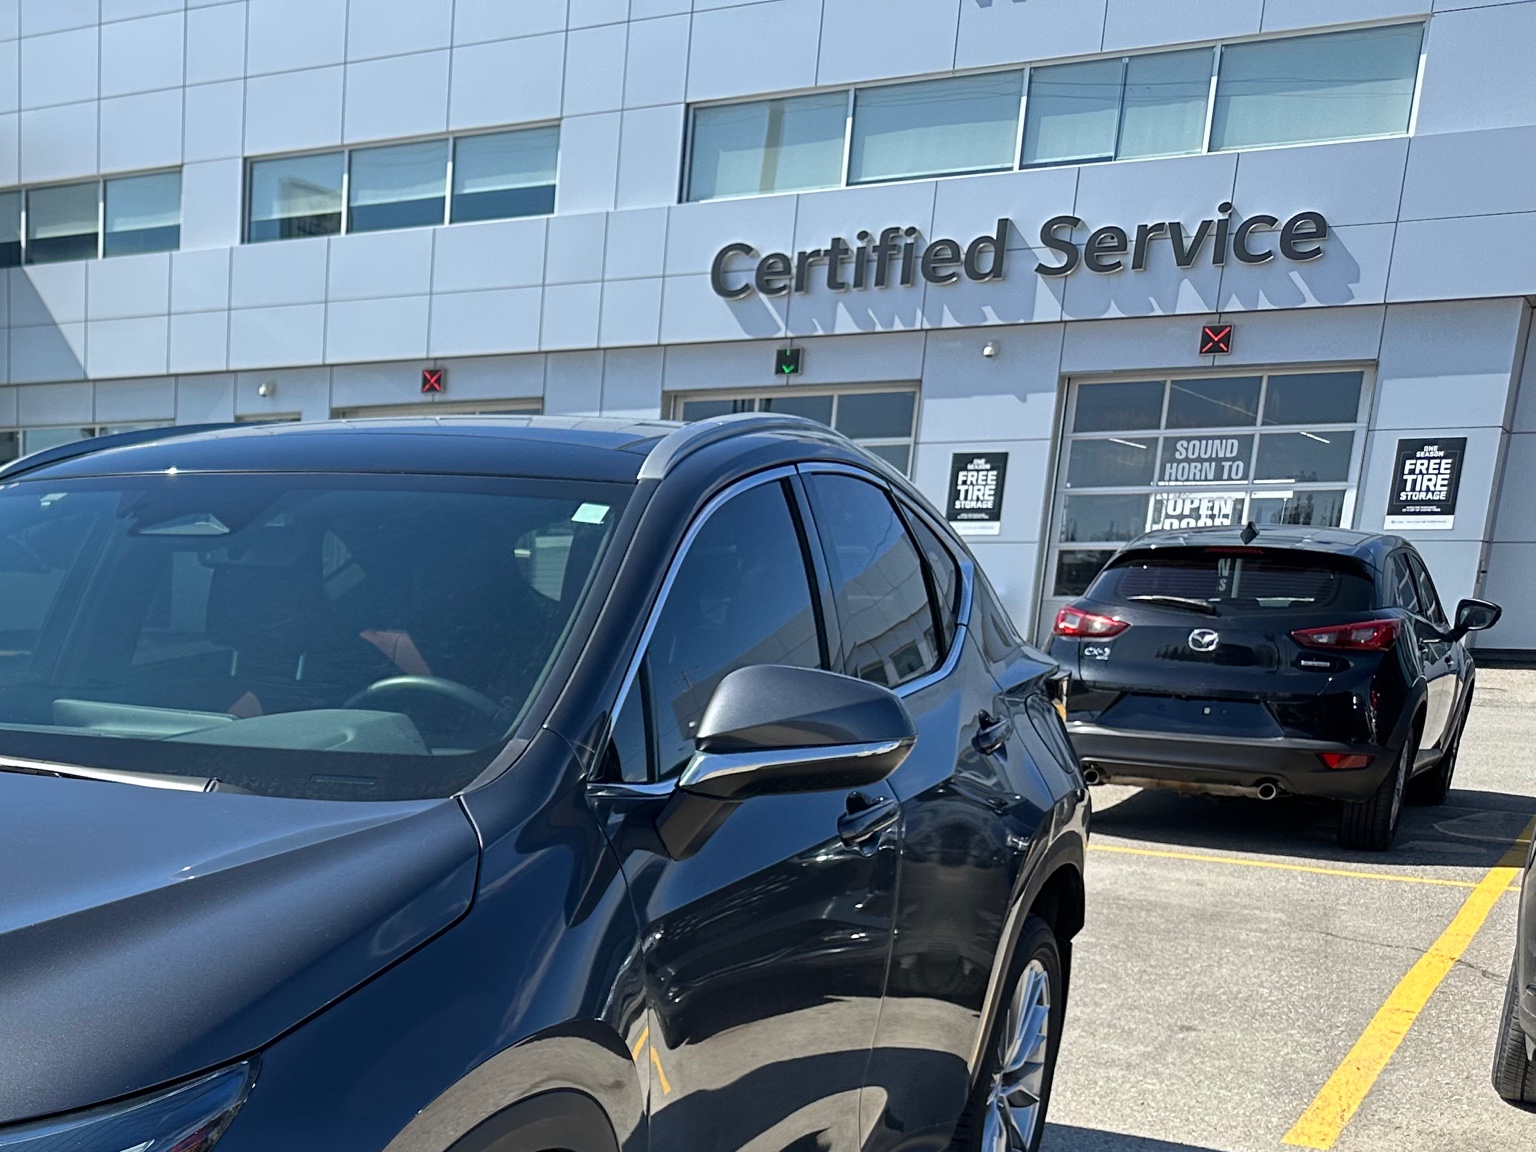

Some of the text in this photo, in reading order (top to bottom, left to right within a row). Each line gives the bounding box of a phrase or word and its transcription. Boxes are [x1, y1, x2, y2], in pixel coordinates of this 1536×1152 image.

[710, 201, 1330, 299] Certified Service
[1175, 439, 1239, 460] SOUND
[1164, 461, 1244, 481] HORN TO
[1403, 459, 1453, 475] FREE
[957, 470, 998, 485] FREE
[1402, 474, 1450, 492] TIRE
[956, 484, 996, 501] TIRE
[1399, 491, 1447, 501] STORAGE
[954, 500, 994, 509] STORAGE
[1166, 496, 1233, 516] OPEN
